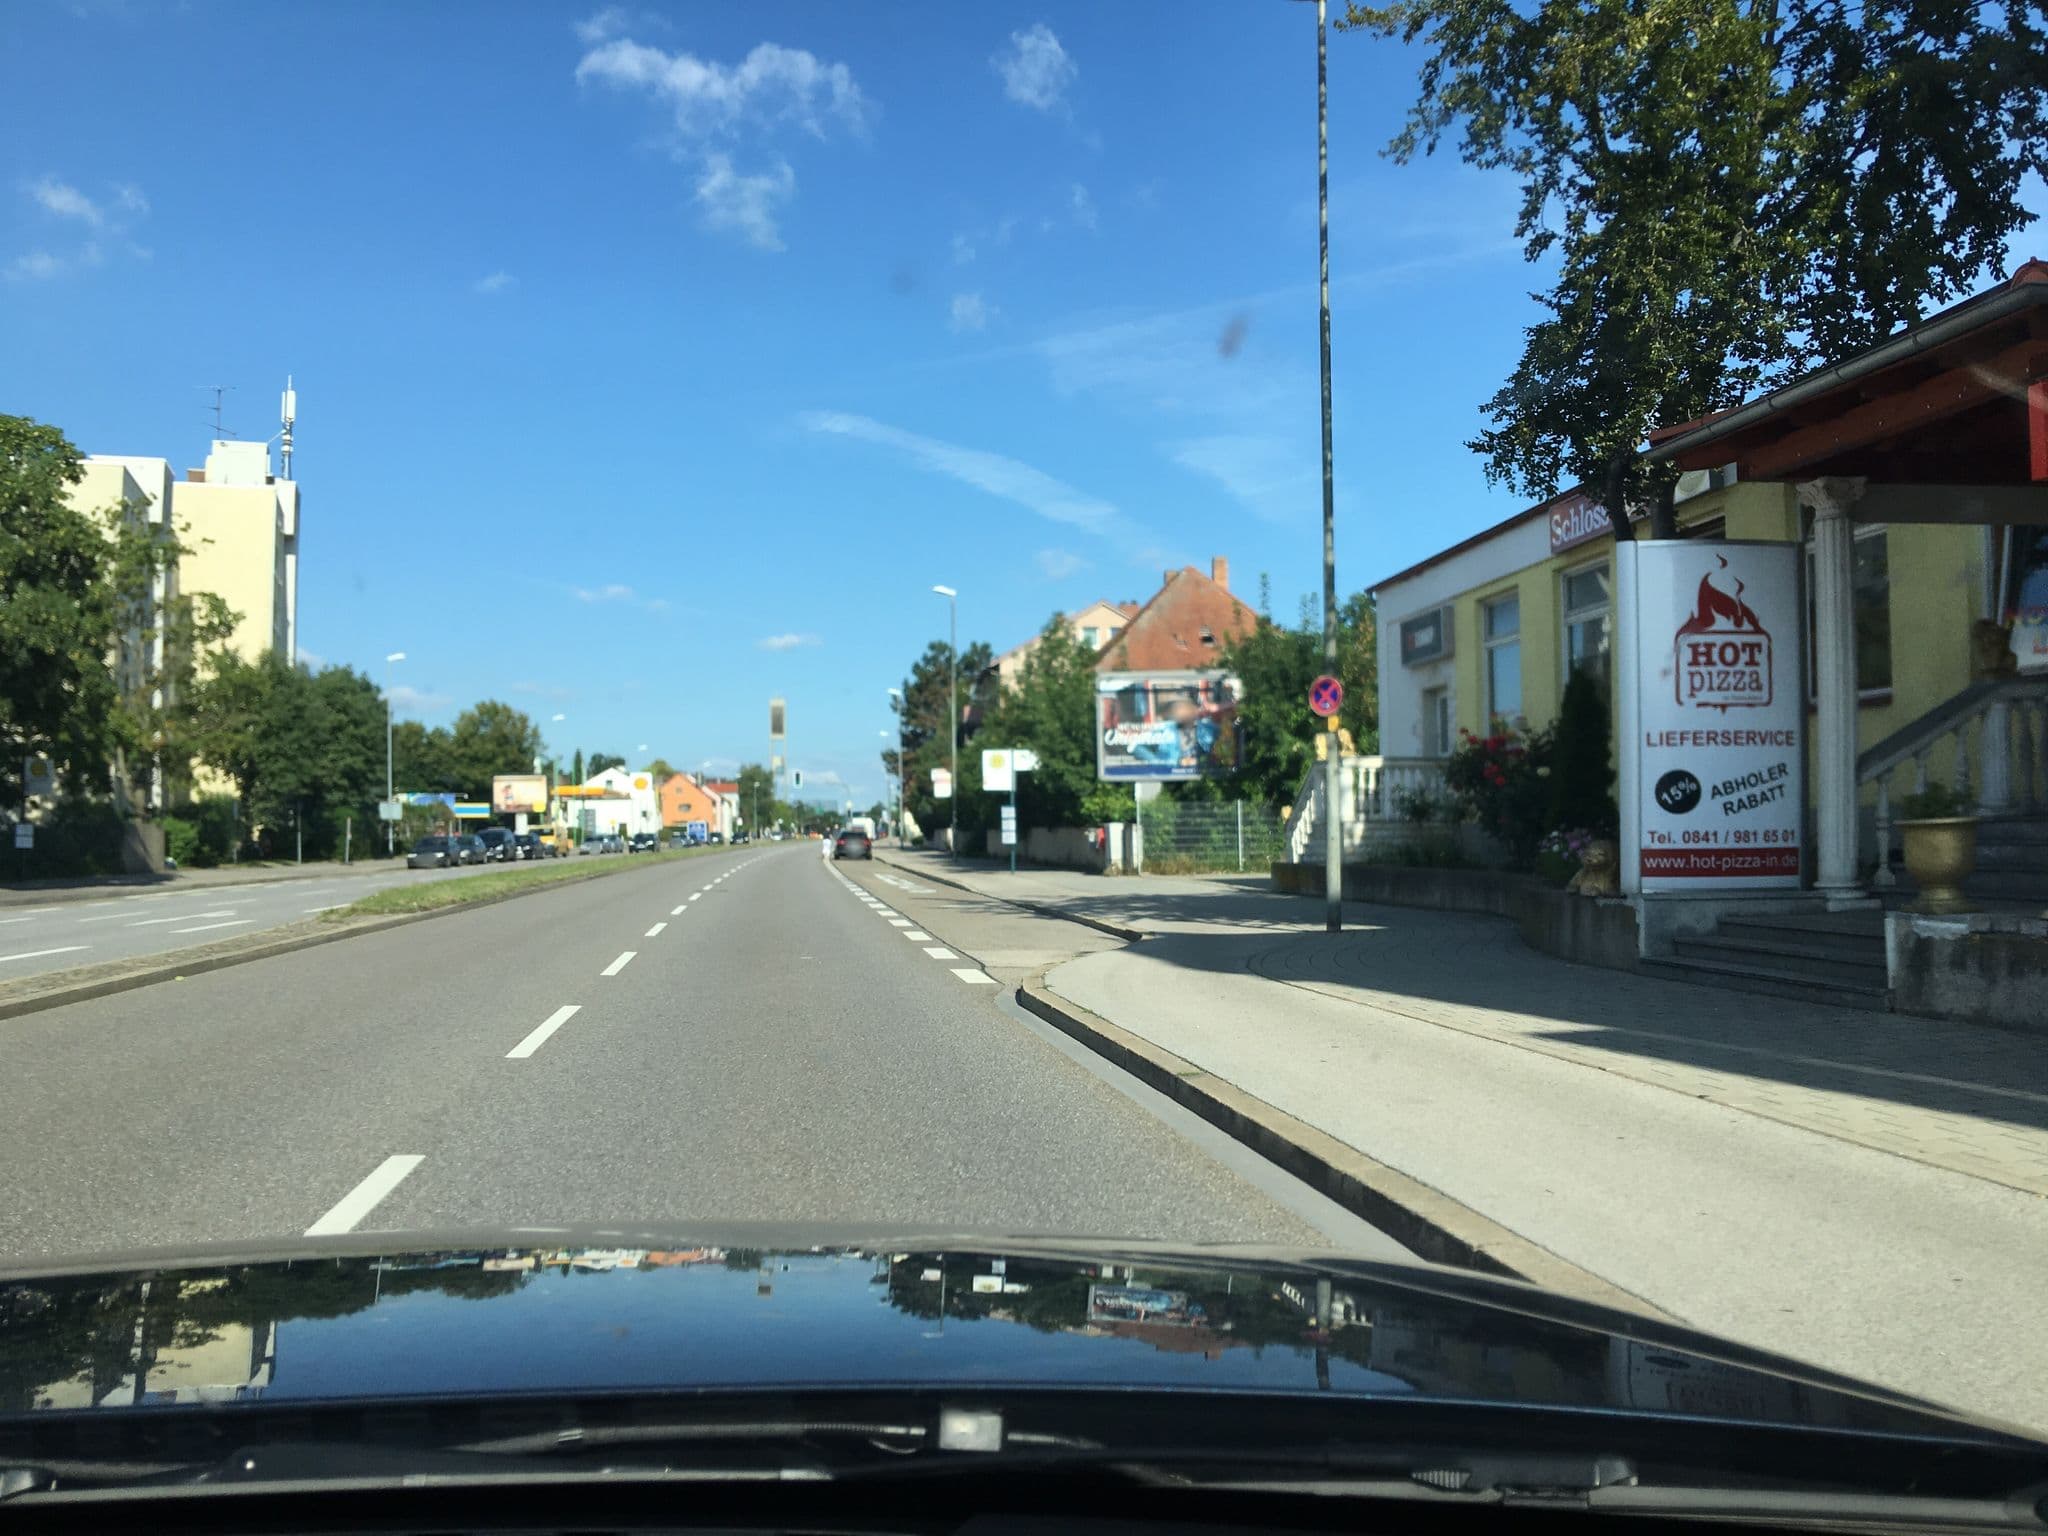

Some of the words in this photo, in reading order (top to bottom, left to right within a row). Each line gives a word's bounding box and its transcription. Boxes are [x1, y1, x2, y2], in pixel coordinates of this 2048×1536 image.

[1687, 642, 1763, 667] HOT
[1687, 670, 1763, 698] pizza
[1645, 730, 1795, 747] LIEFERSERVICE
[1660, 777, 1698, 805] 15%
[1710, 762, 1789, 800] ABHOLER
[1722, 784, 1786, 817] RABATT
[1648, 831, 1676, 844] Tel.
[1682, 830, 1718, 844] 0841
[1733, 829, 1758, 843] 981
[1763, 829, 1778, 843] 65
[1644, 854, 1796, 871] www.hot-pizza-in.de
